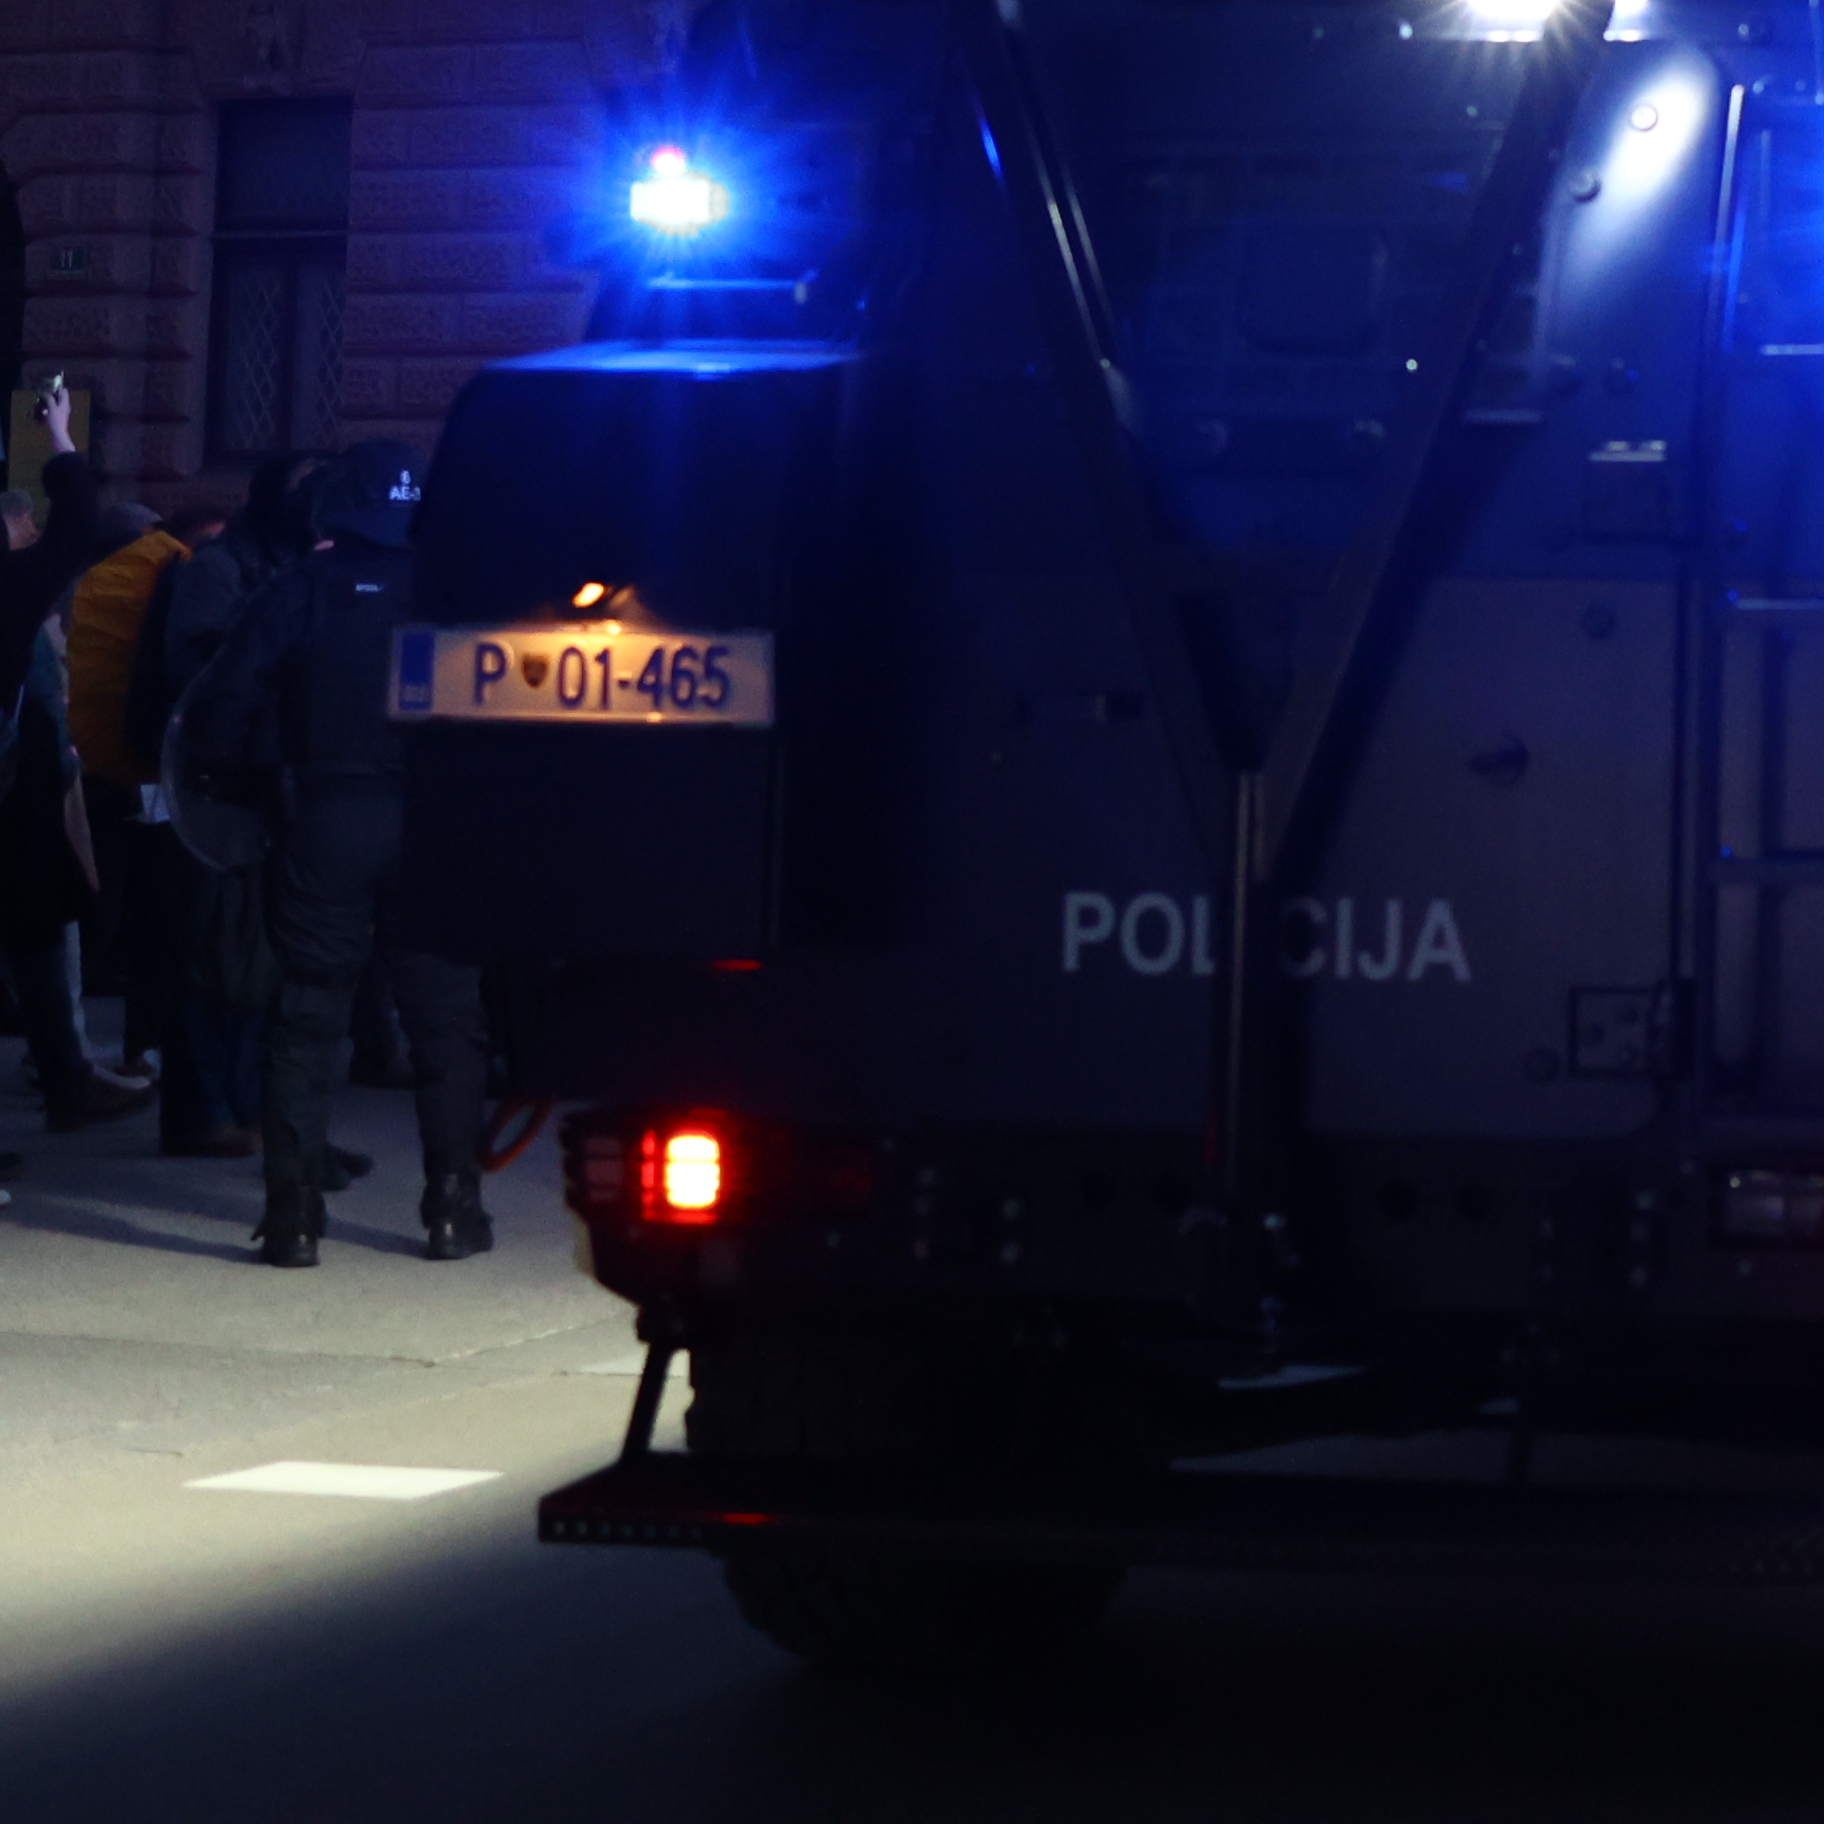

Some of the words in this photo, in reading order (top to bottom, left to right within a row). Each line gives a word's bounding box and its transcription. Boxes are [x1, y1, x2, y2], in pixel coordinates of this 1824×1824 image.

[475, 643, 507, 705] P
[558, 644, 730, 711] 01-465
[1062, 890, 1472, 985] POLCIJA
